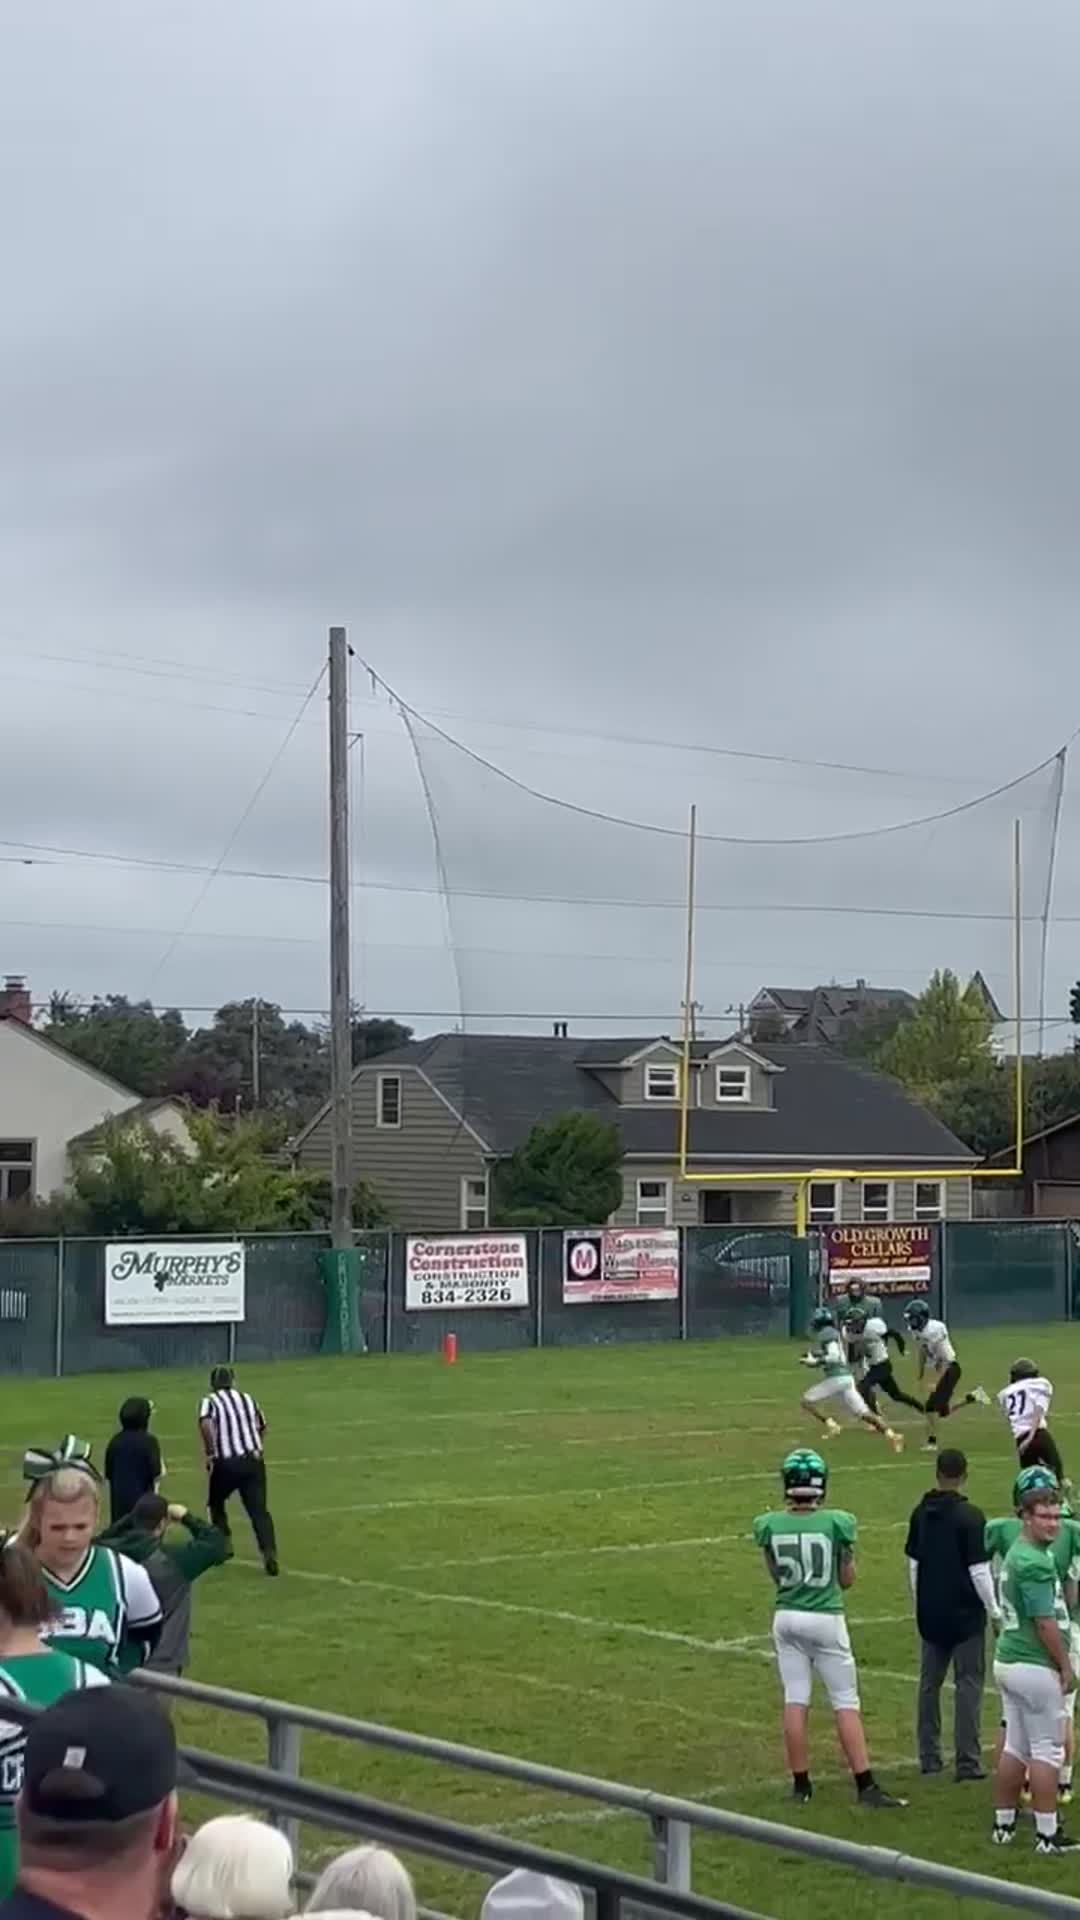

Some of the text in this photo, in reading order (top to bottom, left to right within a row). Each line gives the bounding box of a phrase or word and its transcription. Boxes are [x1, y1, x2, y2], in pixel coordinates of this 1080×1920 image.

[832, 1226, 929, 1244] OLD GROWTH
[413, 1242, 520, 1257] Cornerstone
[851, 1241, 913, 1257] CELLARS
[409, 1256, 524, 1271] Construction
[167, 1273, 230, 1287] MARKETS
[413, 1270, 520, 1281] CONSTRUCTION
[421, 1288, 512, 1304] 834-2326
[1008, 1389, 1027, 1416] 27
